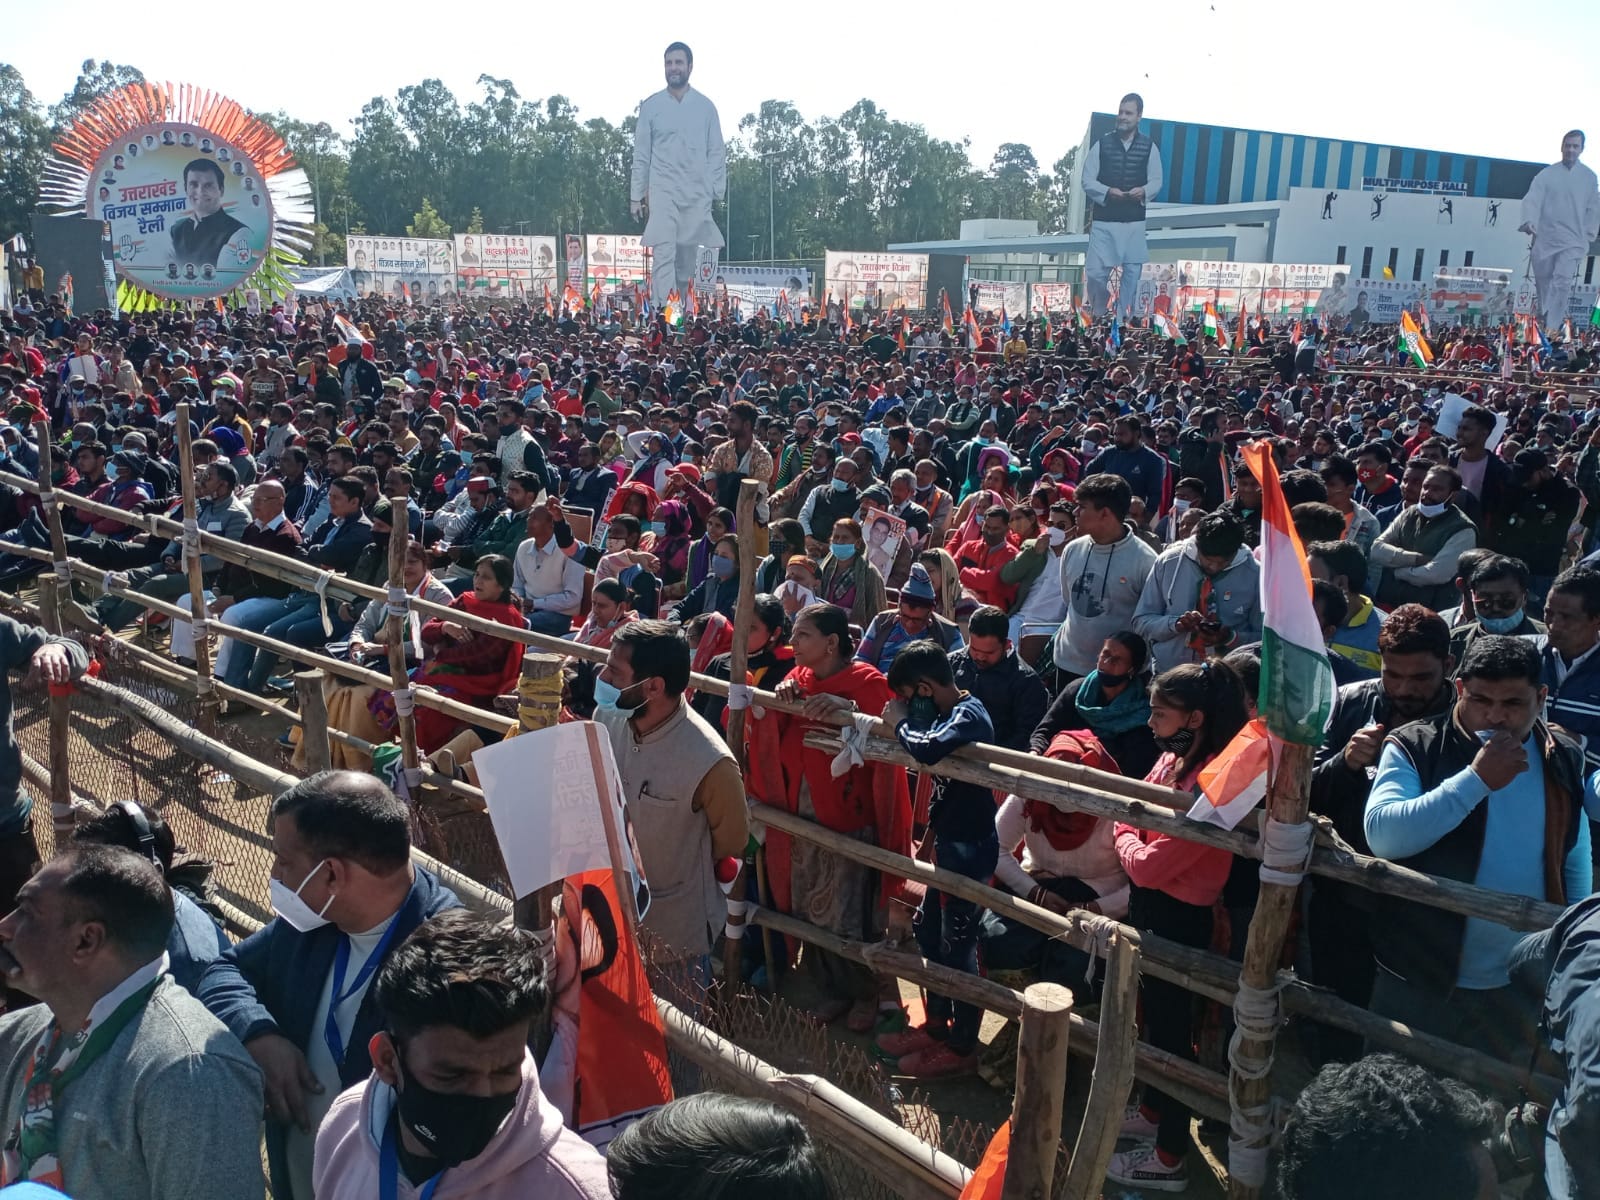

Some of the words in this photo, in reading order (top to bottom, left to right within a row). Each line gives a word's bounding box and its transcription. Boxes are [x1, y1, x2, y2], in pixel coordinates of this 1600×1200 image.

[118, 179, 177, 202] उत्तराखंड
[1363, 178, 1440, 190] MULTIPURPOSE
[1441, 183, 1466, 191] HALL
[102, 204, 138, 220] विजय
[139, 197, 187, 216] सम्मान
[137, 215, 165, 234] रैली
